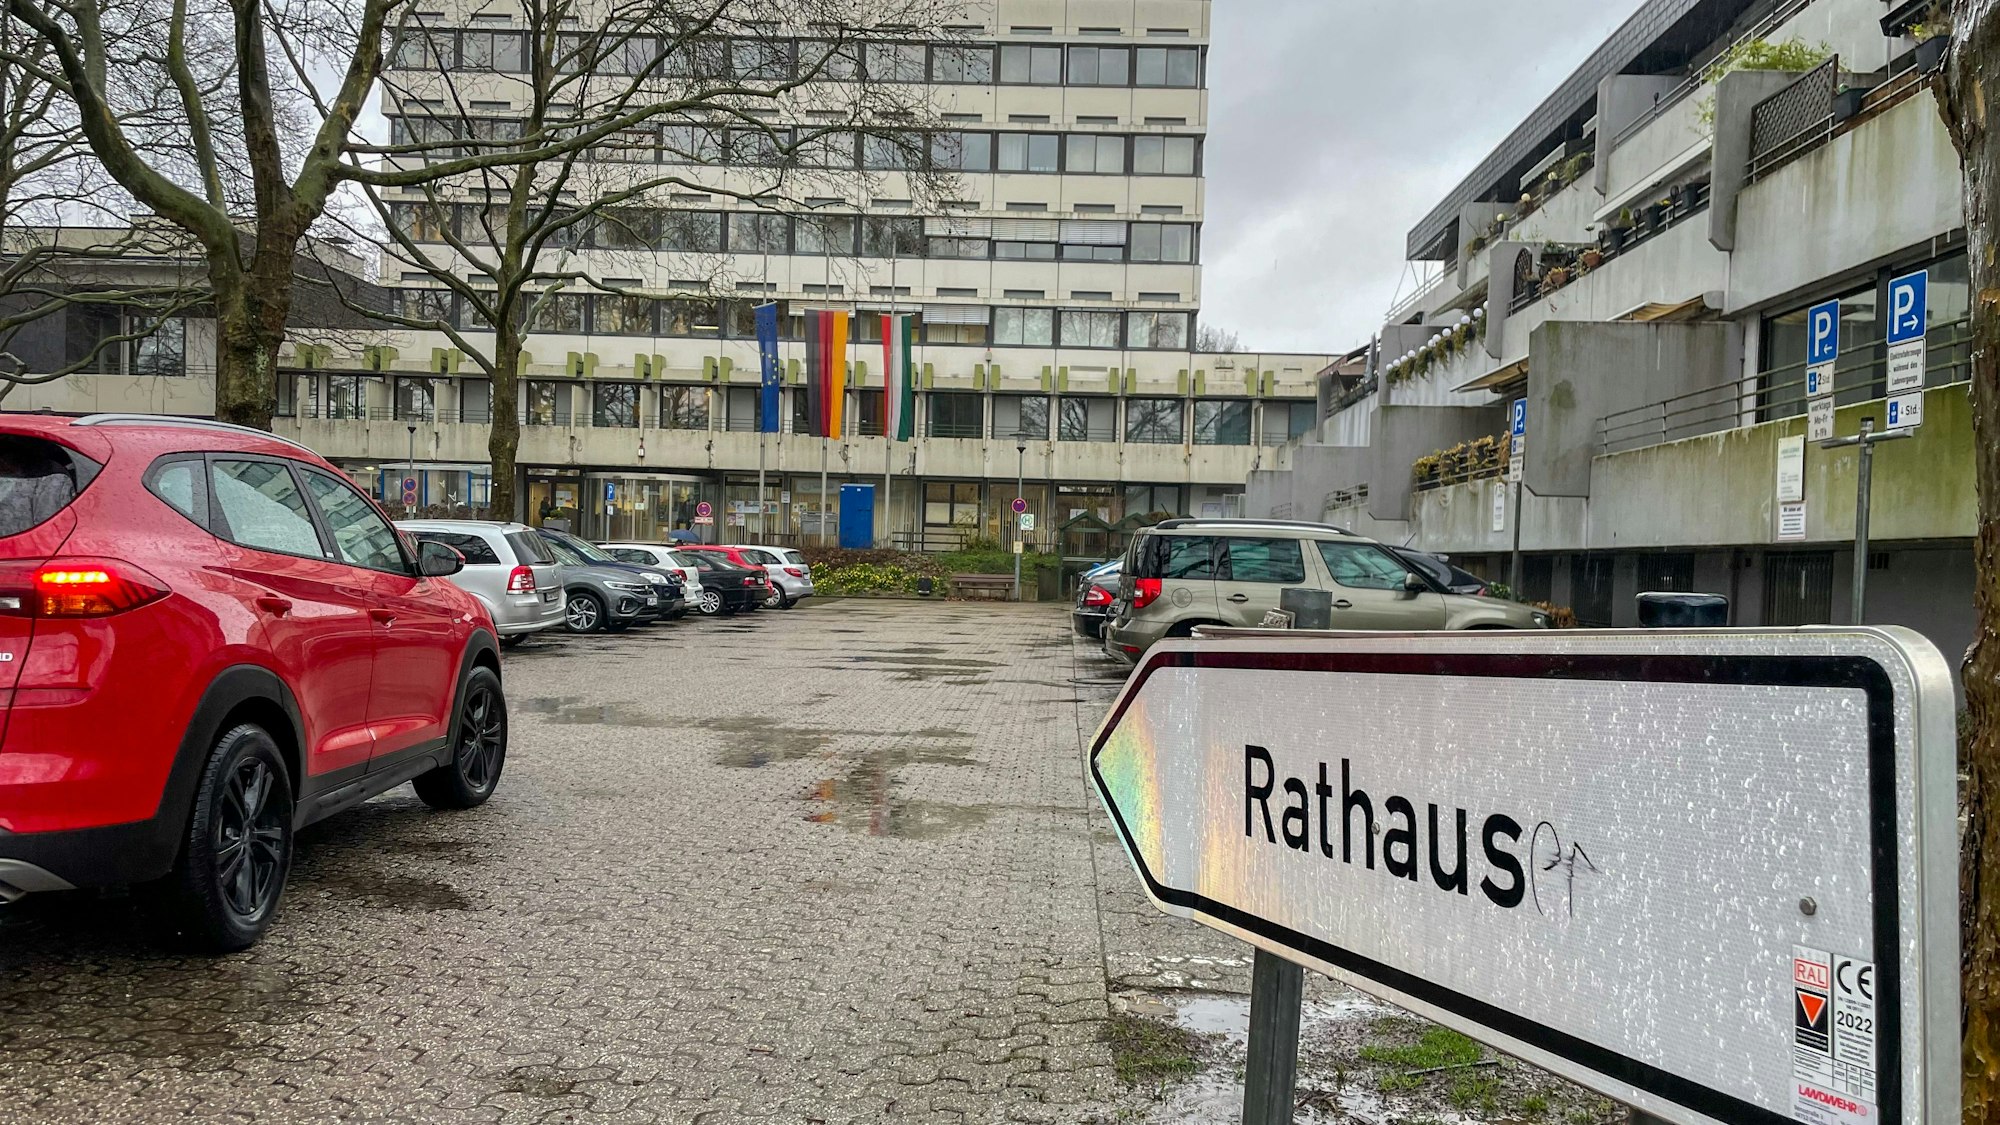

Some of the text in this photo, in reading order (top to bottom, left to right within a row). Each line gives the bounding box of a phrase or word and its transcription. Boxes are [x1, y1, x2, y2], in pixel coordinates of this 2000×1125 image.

[1894, 284, 1915, 335] P
[1815, 311, 1832, 357] P
[1817, 373, 1822, 385] 2
[1514, 404, 1523, 432] P
[608, 485, 614, 499] P
[1245, 744, 1525, 908] Rathaus
[1797, 963, 1825, 984] RAL
[1836, 960, 1873, 1000] CE
[1837, 1010, 1873, 1034] 2022
[1798, 1084, 1858, 1114] LANDWEHR
